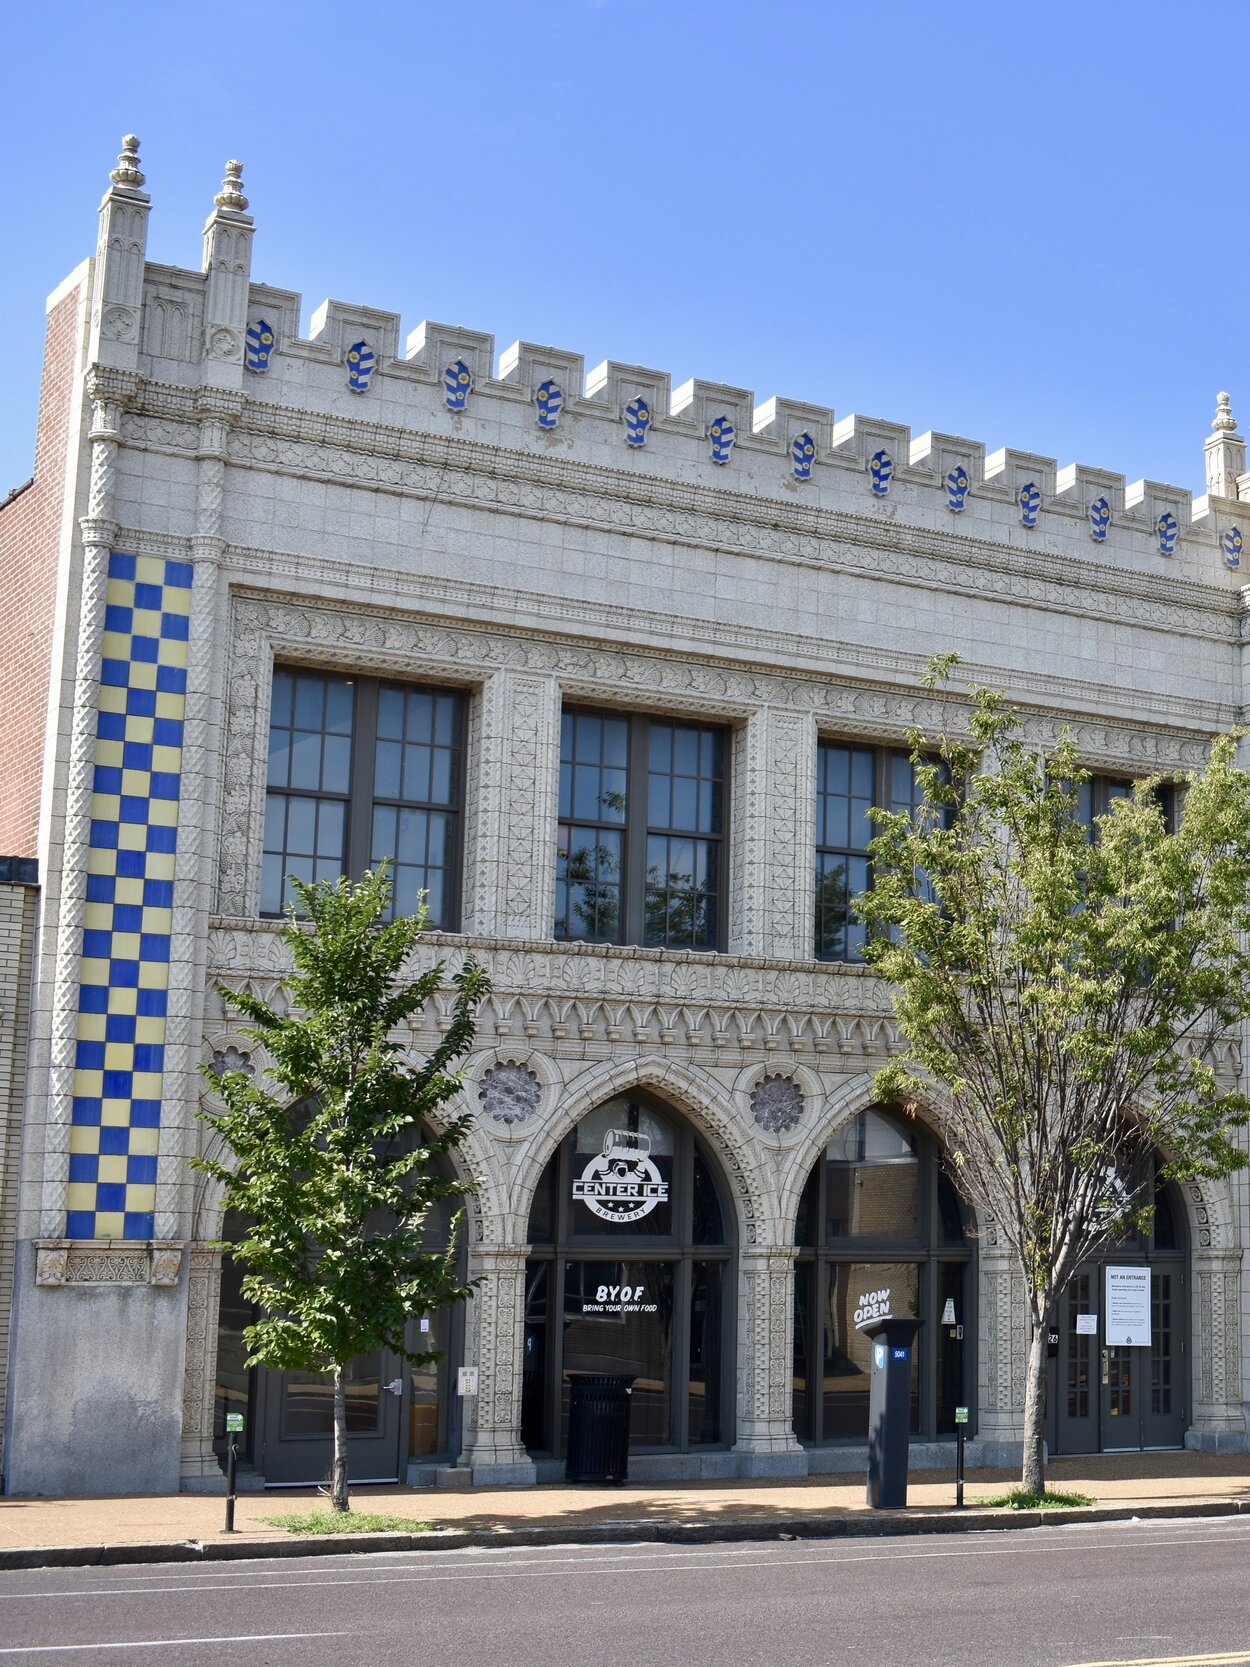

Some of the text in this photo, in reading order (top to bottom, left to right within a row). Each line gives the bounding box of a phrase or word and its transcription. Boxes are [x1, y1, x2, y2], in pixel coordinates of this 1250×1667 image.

[572, 1182, 669, 1197] CENTER ICE
[596, 1207, 646, 1220] BREWERY
[859, 1289, 890, 1306] NOW
[582, 1304, 658, 1312] BRING YOUR OWN FOOD
[853, 1301, 890, 1322] OPEN
[894, 1350, 905, 1358] 5041
